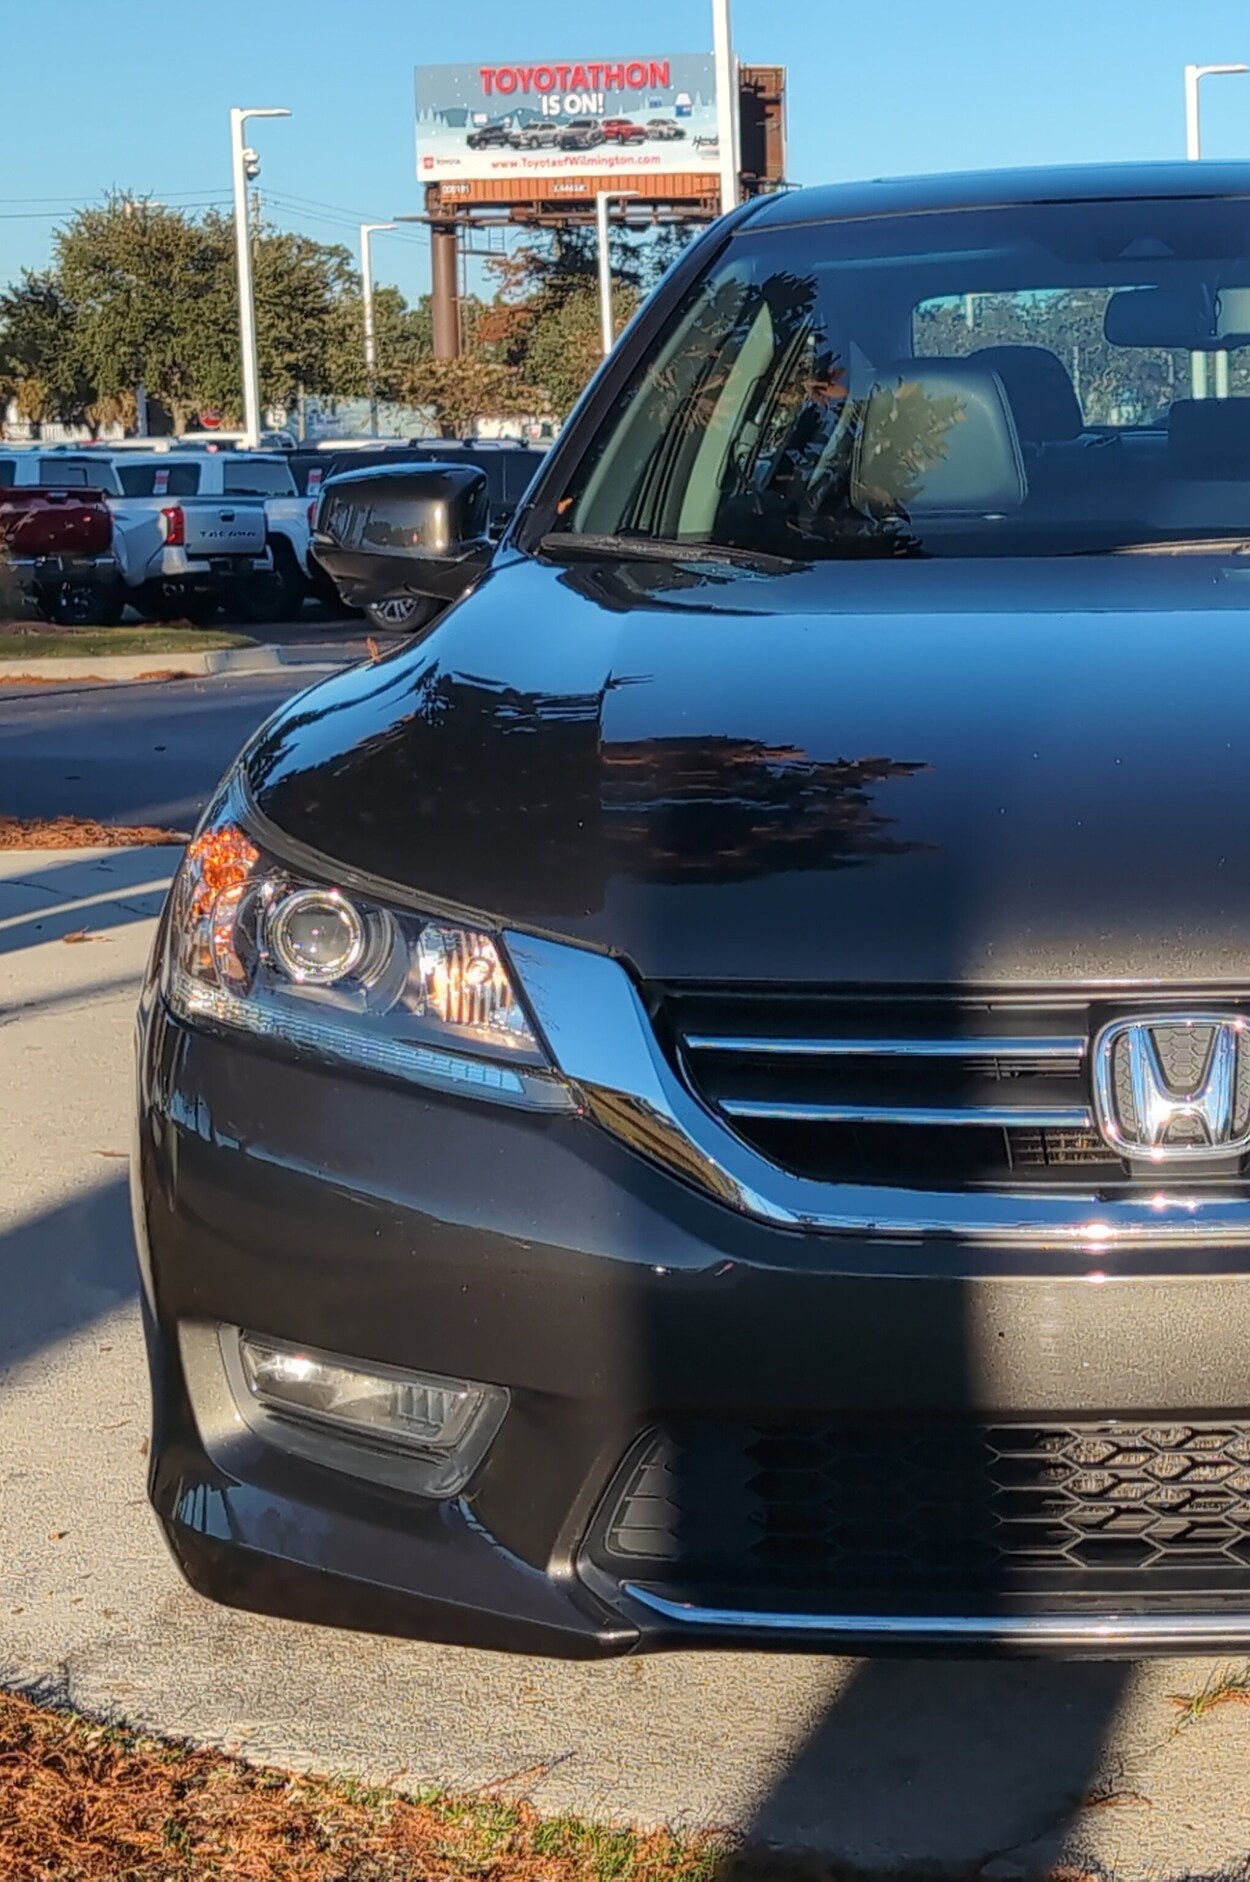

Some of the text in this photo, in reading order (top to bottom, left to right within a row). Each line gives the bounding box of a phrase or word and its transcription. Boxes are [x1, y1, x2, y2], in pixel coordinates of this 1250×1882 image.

[480, 61, 670, 95] TOYOTATHON
[541, 93, 604, 117] IS ON!
[490, 154, 662, 170] www.ToyotaofWilmington.com
